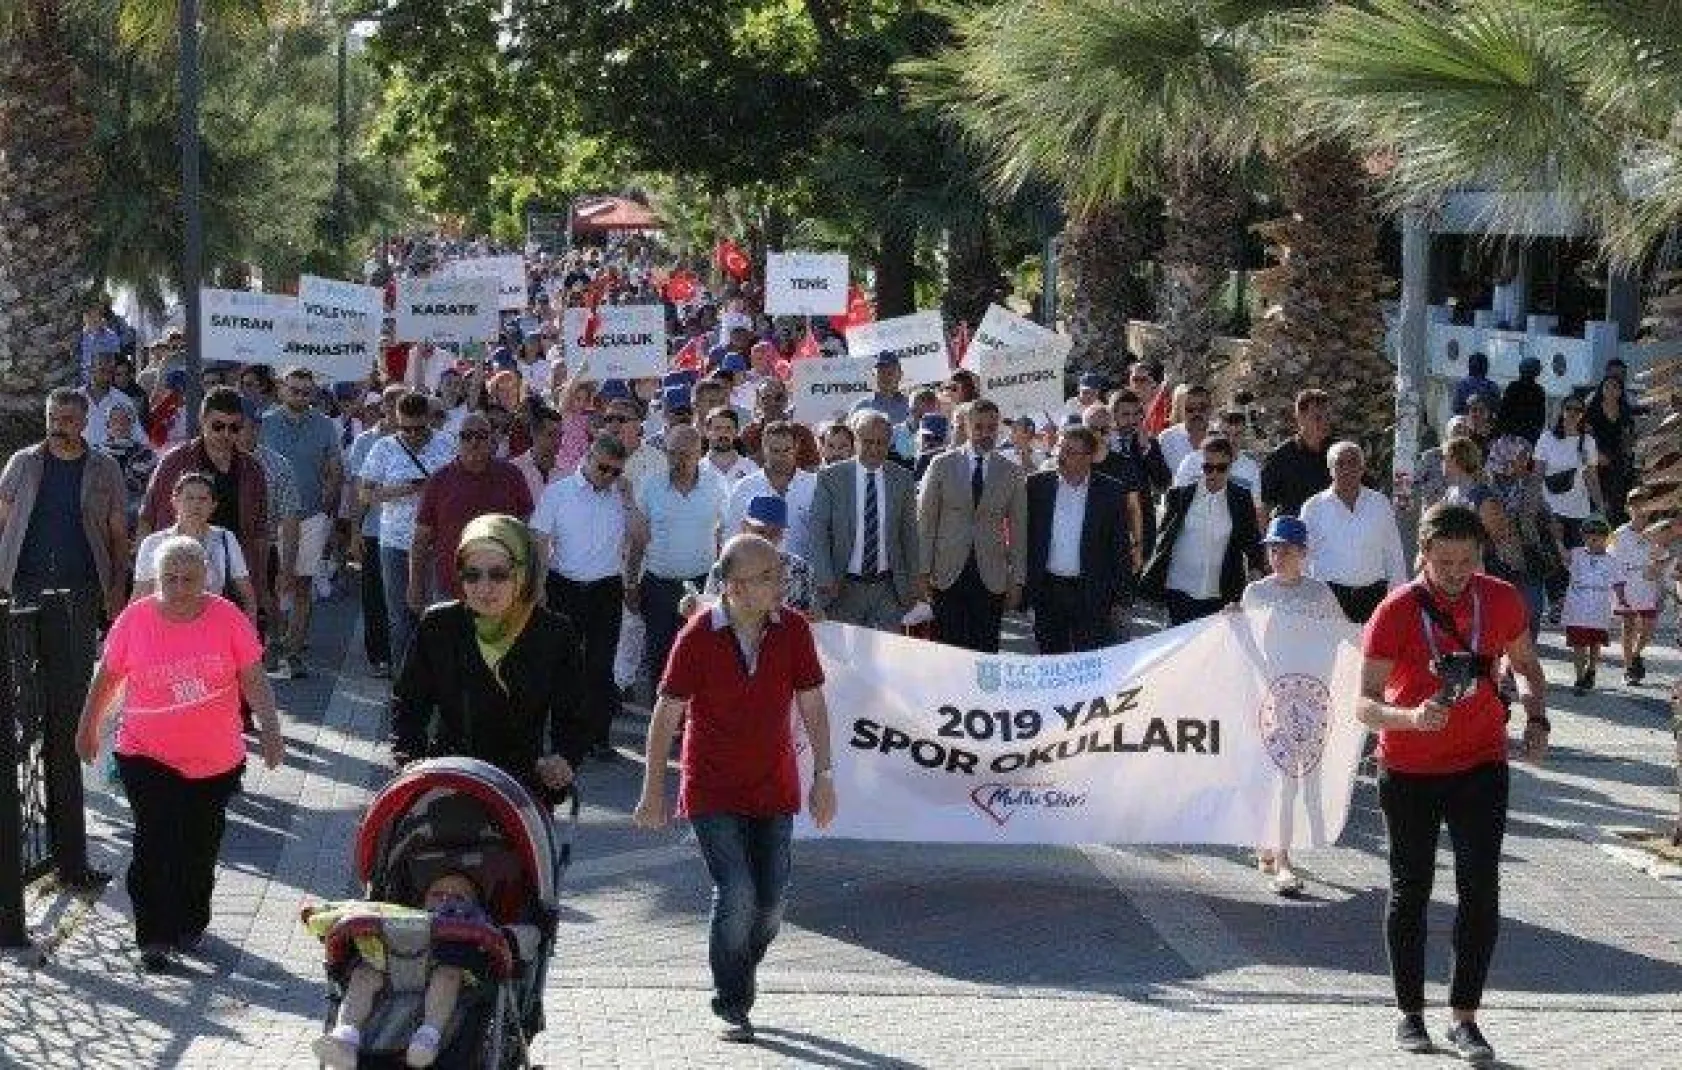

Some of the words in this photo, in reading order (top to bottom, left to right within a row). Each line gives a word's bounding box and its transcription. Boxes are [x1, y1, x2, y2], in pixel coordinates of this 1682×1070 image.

[411, 304, 478, 317] KARATE
[811, 380, 873, 395] FUTBOL
[987, 370, 1057, 390] BASKETBOL
[938, 703, 1041, 743] 2019
[1053, 685, 1144, 730] YAZ
[849, 717, 979, 775] SPOR
[989, 717, 1221, 774] OKULLARI
